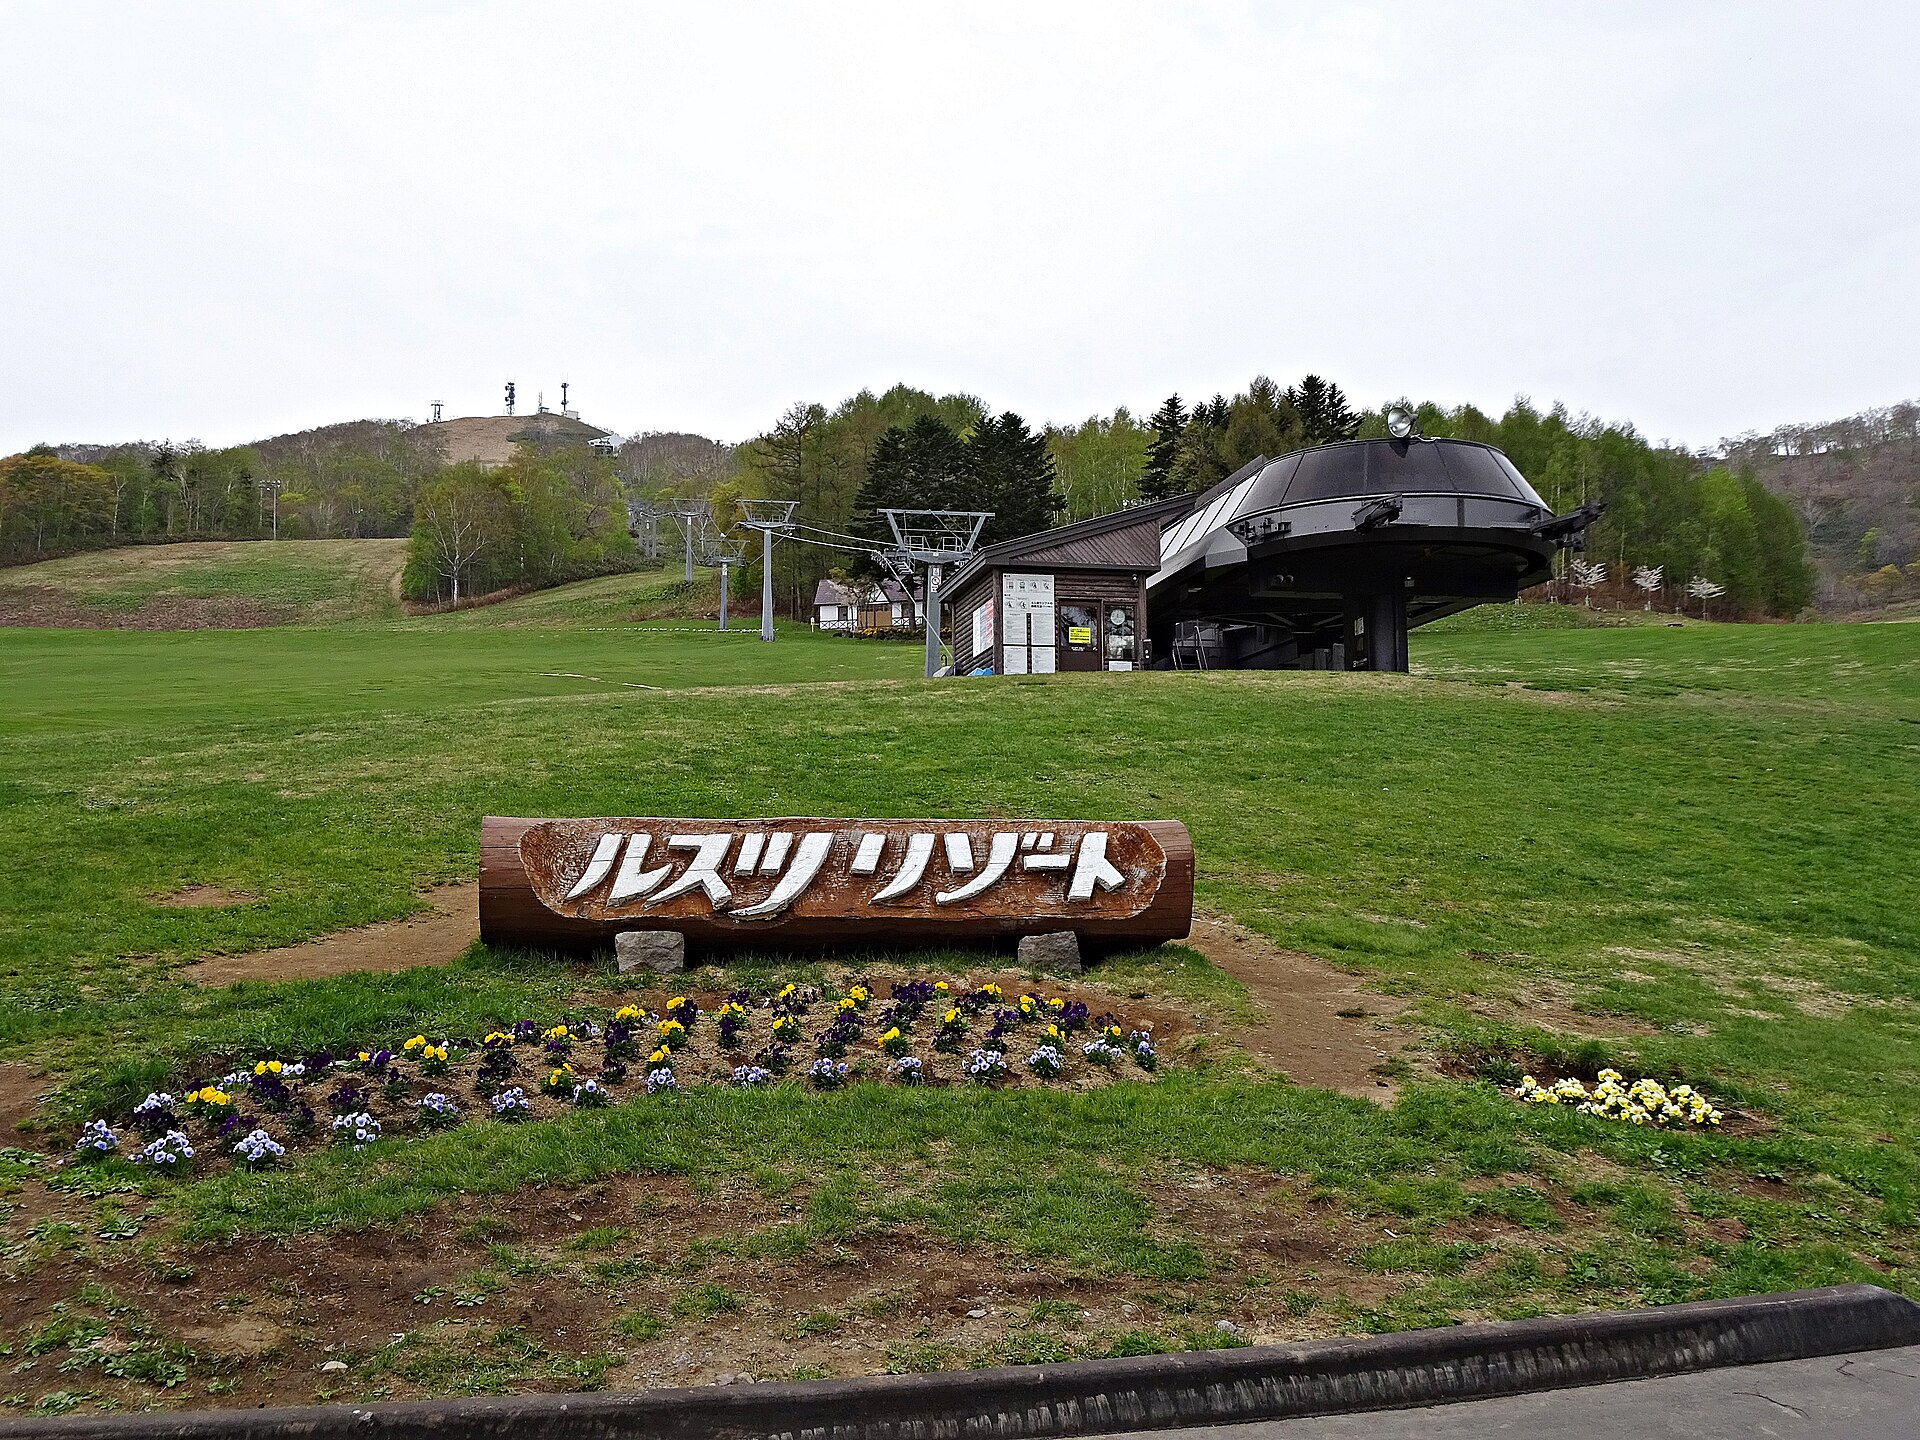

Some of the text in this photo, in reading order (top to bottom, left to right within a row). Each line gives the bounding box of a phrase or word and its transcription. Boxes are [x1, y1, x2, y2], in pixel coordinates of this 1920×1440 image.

[566, 831, 1126, 917] ルスツリゾート
